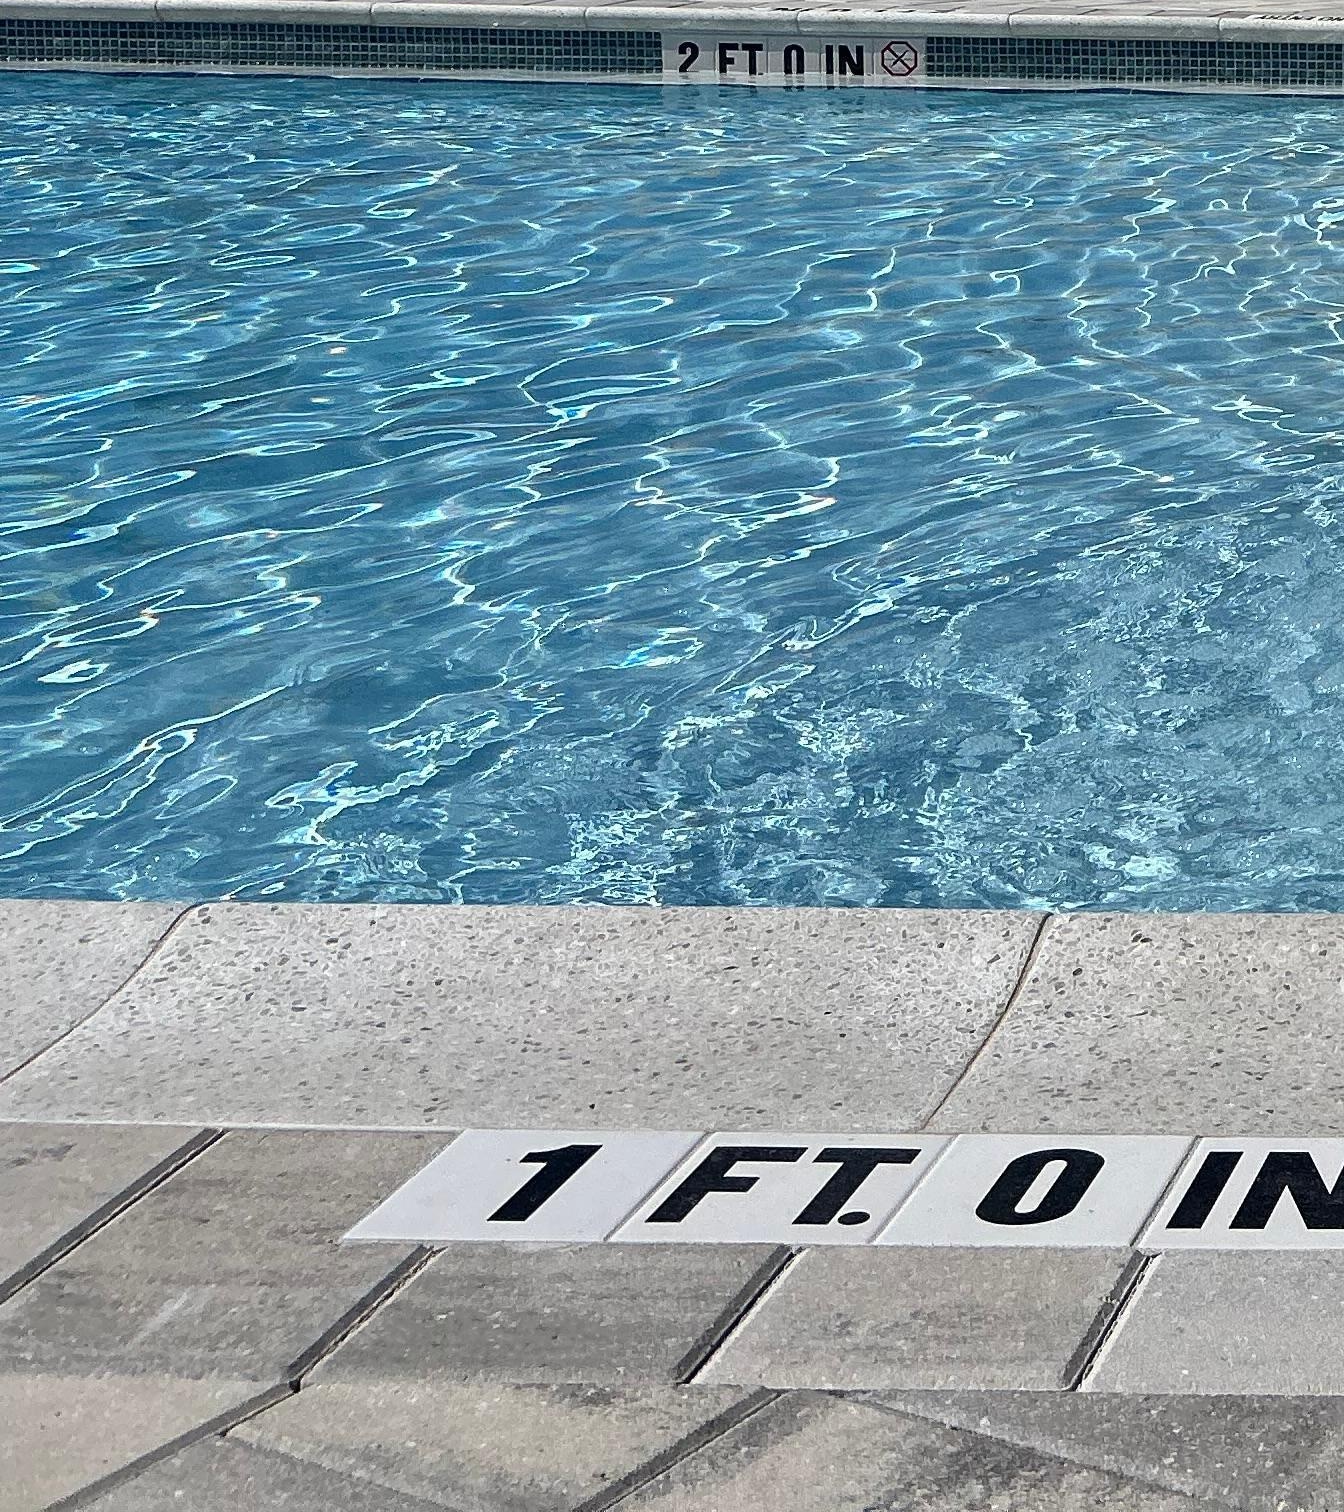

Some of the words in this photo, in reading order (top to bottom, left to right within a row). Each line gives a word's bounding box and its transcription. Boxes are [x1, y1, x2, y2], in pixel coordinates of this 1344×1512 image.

[678, 41, 700, 73] 2
[486, 1143, 603, 1223] 1
[643, 1145, 923, 1227] FT.
[974, 1147, 1106, 1226] 0
